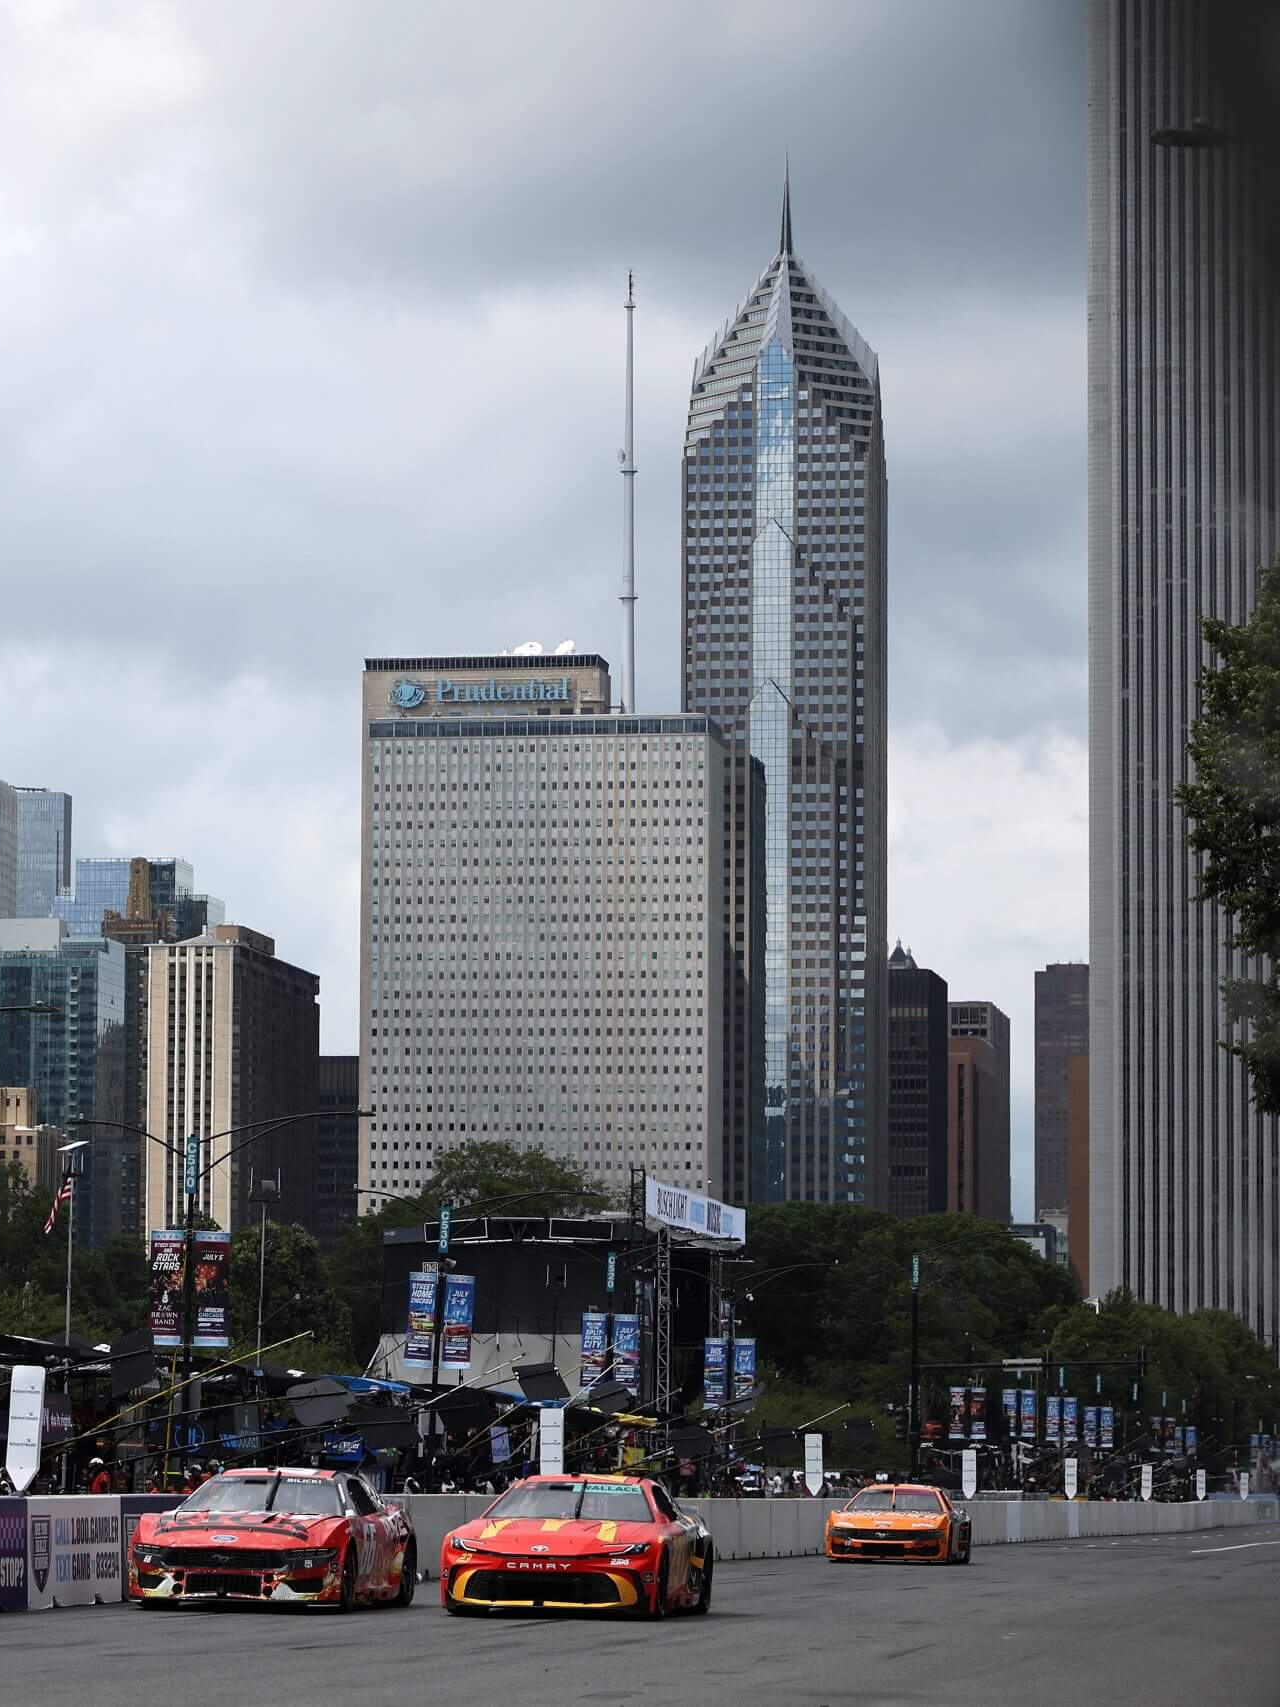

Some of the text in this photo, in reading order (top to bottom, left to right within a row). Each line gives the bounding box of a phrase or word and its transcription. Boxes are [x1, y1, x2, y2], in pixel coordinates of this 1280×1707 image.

[436, 676, 571, 702] Prudential
[186, 1142, 197, 1188] C540
[440, 1211, 449, 1249] C530
[156, 1252, 180, 1262] ROCK
[202, 1253, 225, 1261] JULY 5
[152, 1262, 181, 1272] STARS
[607, 1256, 615, 1288] C520
[412, 1290, 433, 1298] HOME
[452, 1290, 469, 1298] JULY
[585, 1328, 604, 1336] SPLIT-
[583, 1340, 602, 1348] CITY
[584, 1485, 639, 1493] WALLACE
[71, 1516, 119, 1545] 1.800.GAMBLER
[56, 1554, 71, 1582] TEXT
[72, 1553, 91, 1581] GAMB
[507, 1561, 572, 1570] CAMRY
